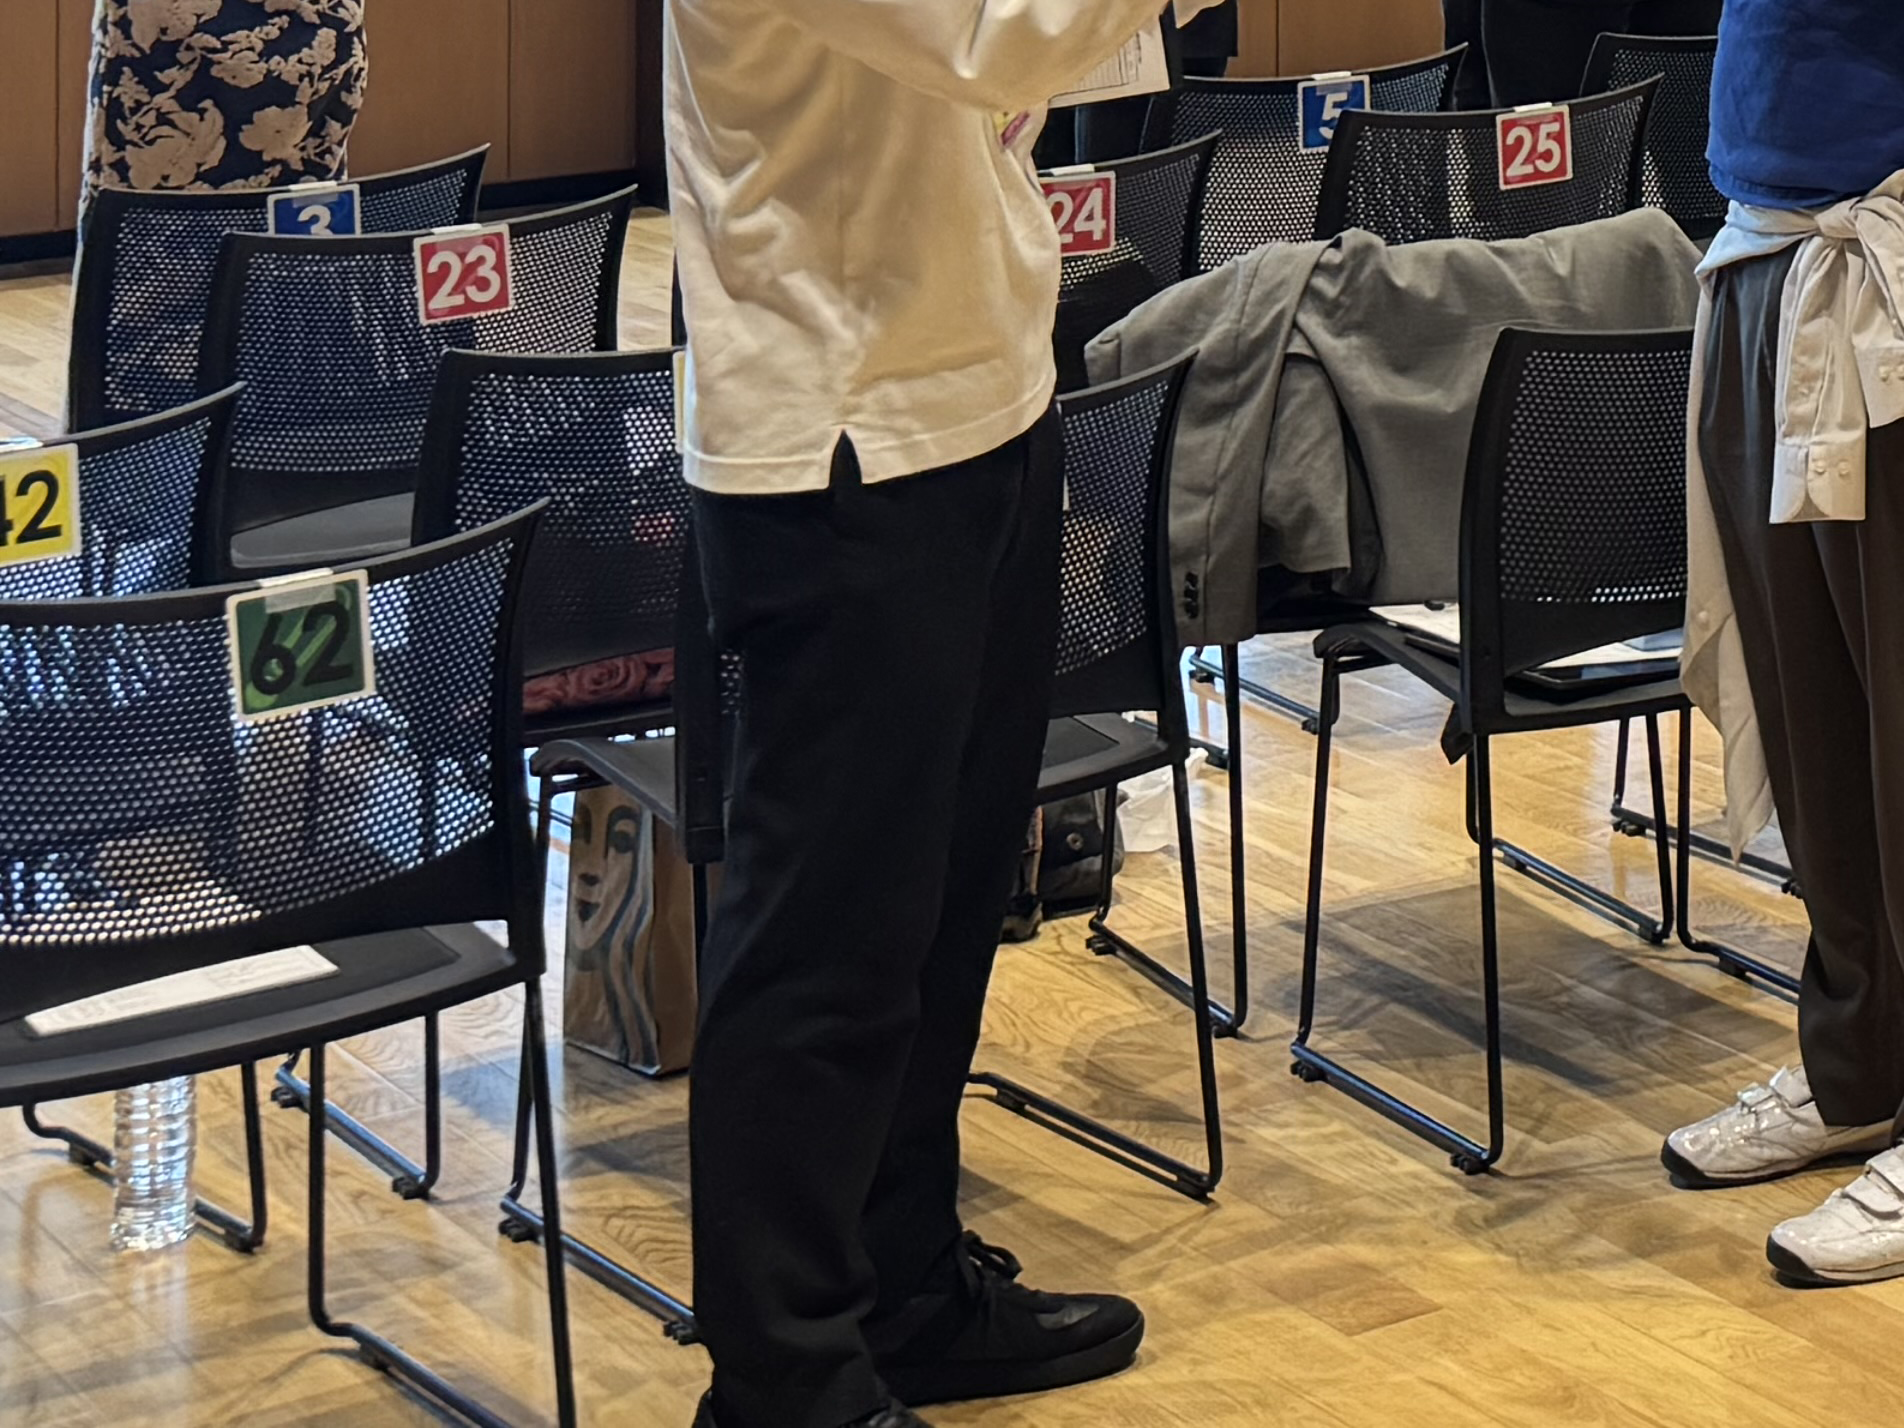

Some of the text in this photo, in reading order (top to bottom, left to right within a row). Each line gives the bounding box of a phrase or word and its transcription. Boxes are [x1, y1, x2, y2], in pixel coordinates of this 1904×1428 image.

[1319, 92, 1347, 140] 5
[1506, 122, 1562, 177] 25
[1046, 187, 1107, 244] 24
[428, 244, 501, 310] 23
[252, 600, 354, 696] 62
